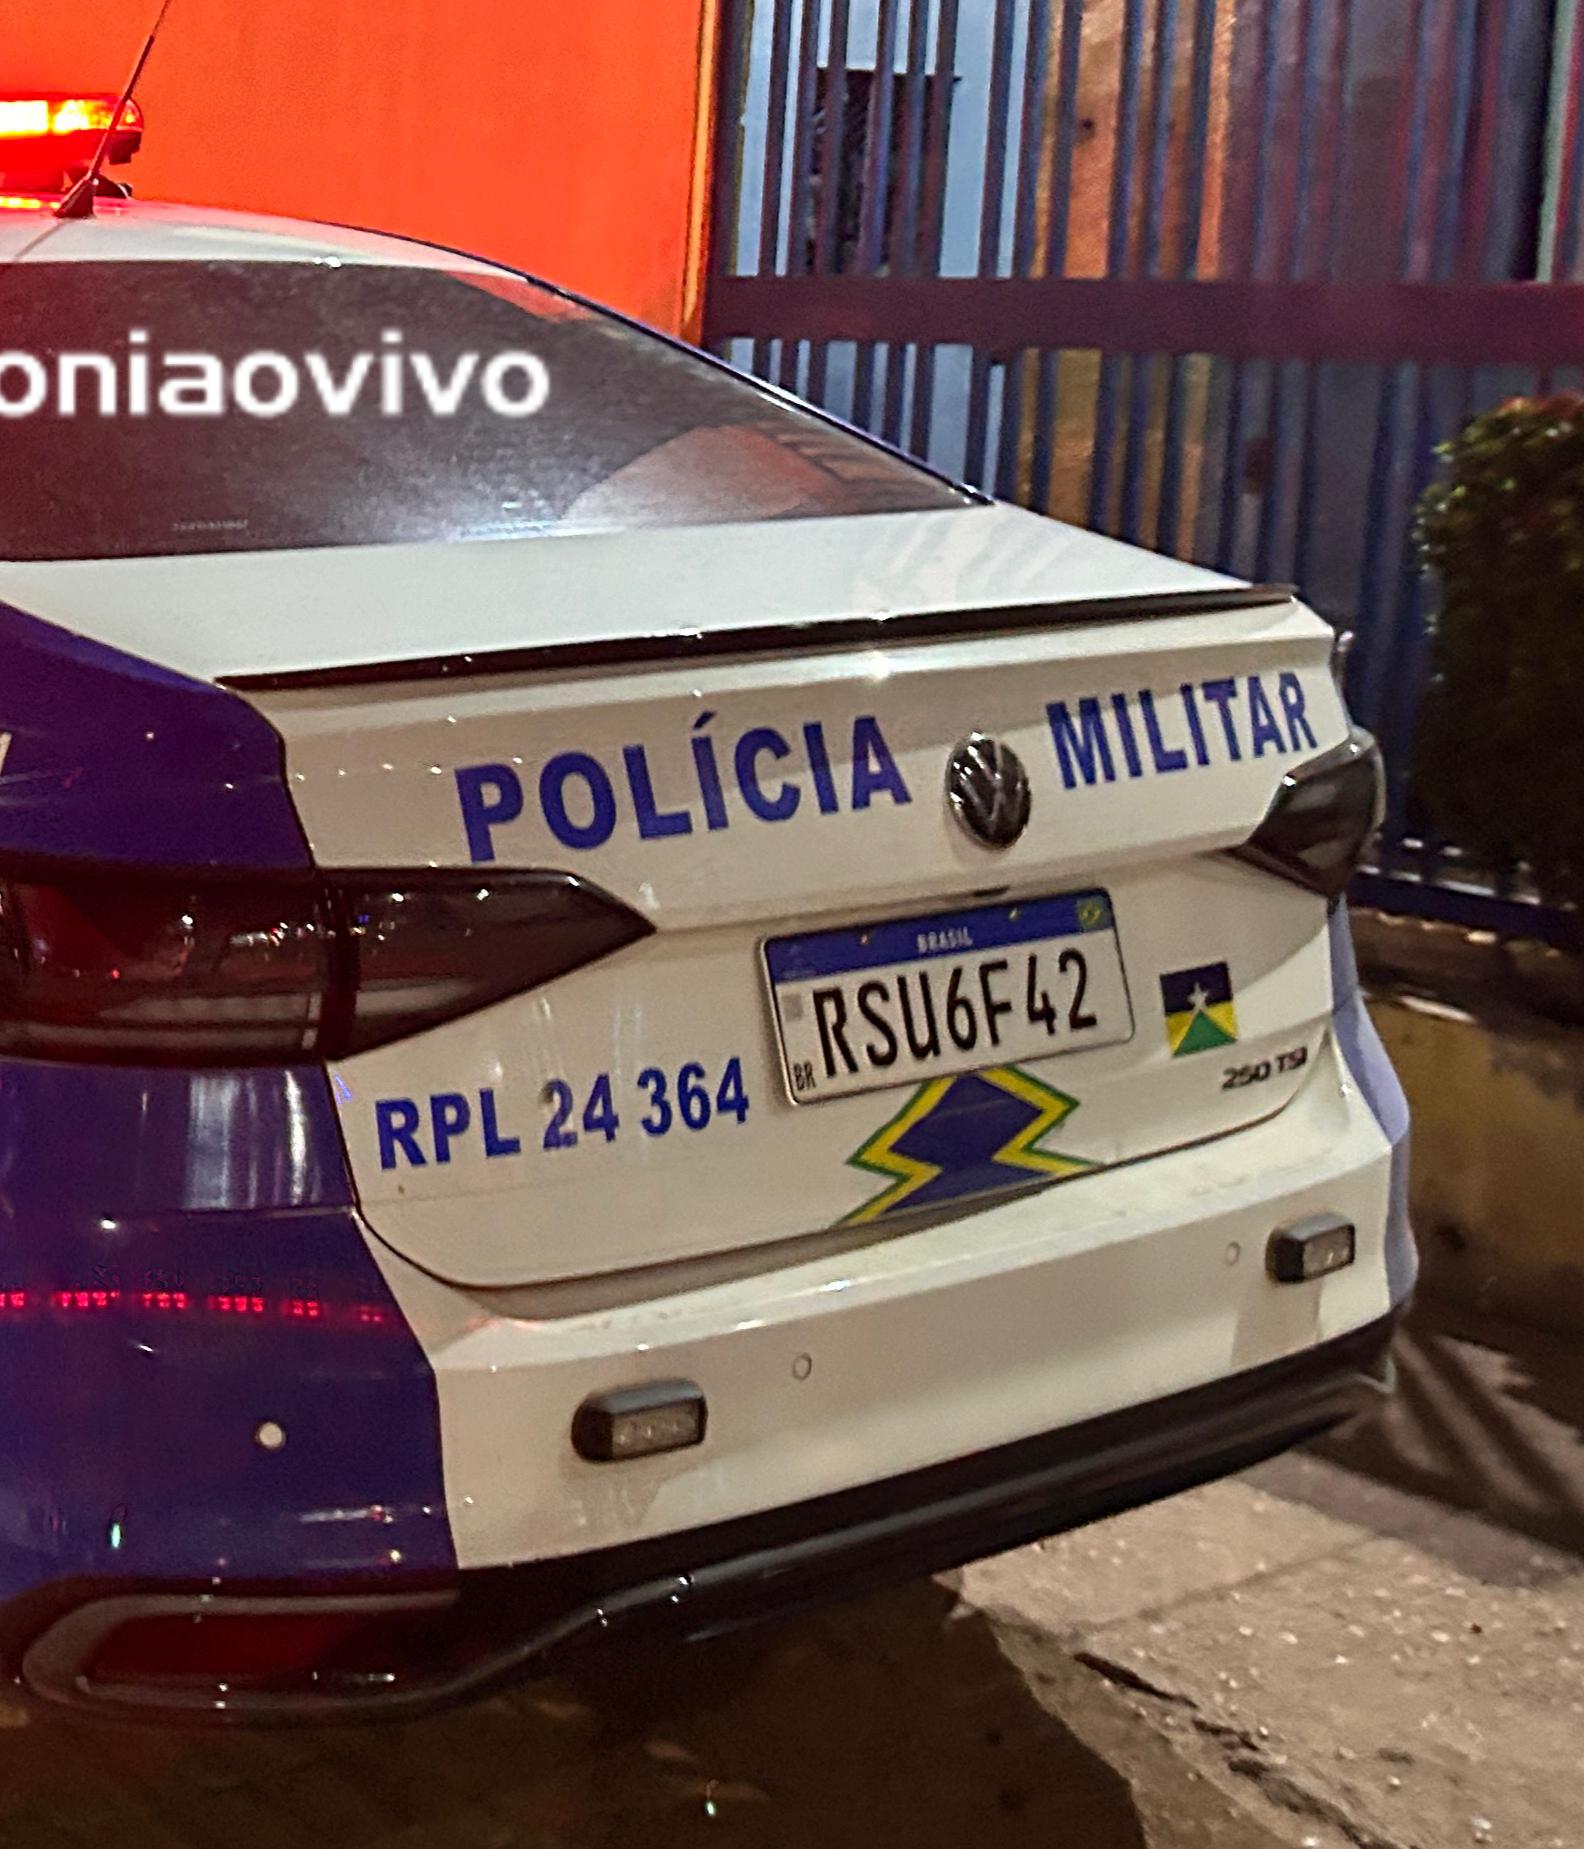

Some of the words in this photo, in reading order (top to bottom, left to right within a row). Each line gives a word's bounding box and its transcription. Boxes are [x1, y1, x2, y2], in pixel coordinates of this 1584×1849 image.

[453, 711, 913, 863] POLÍCIA
[1045, 671, 1318, 790] MILITAR
[917, 926, 974, 954] BRASIL
[812, 947, 1098, 1079] RSU6F42
[375, 1087, 521, 1171] RPL
[539, 1072, 620, 1152] 24
[636, 1055, 750, 1138] 364
[791, 1060, 817, 1092] BR
[1221, 1061, 1272, 1091] 250
